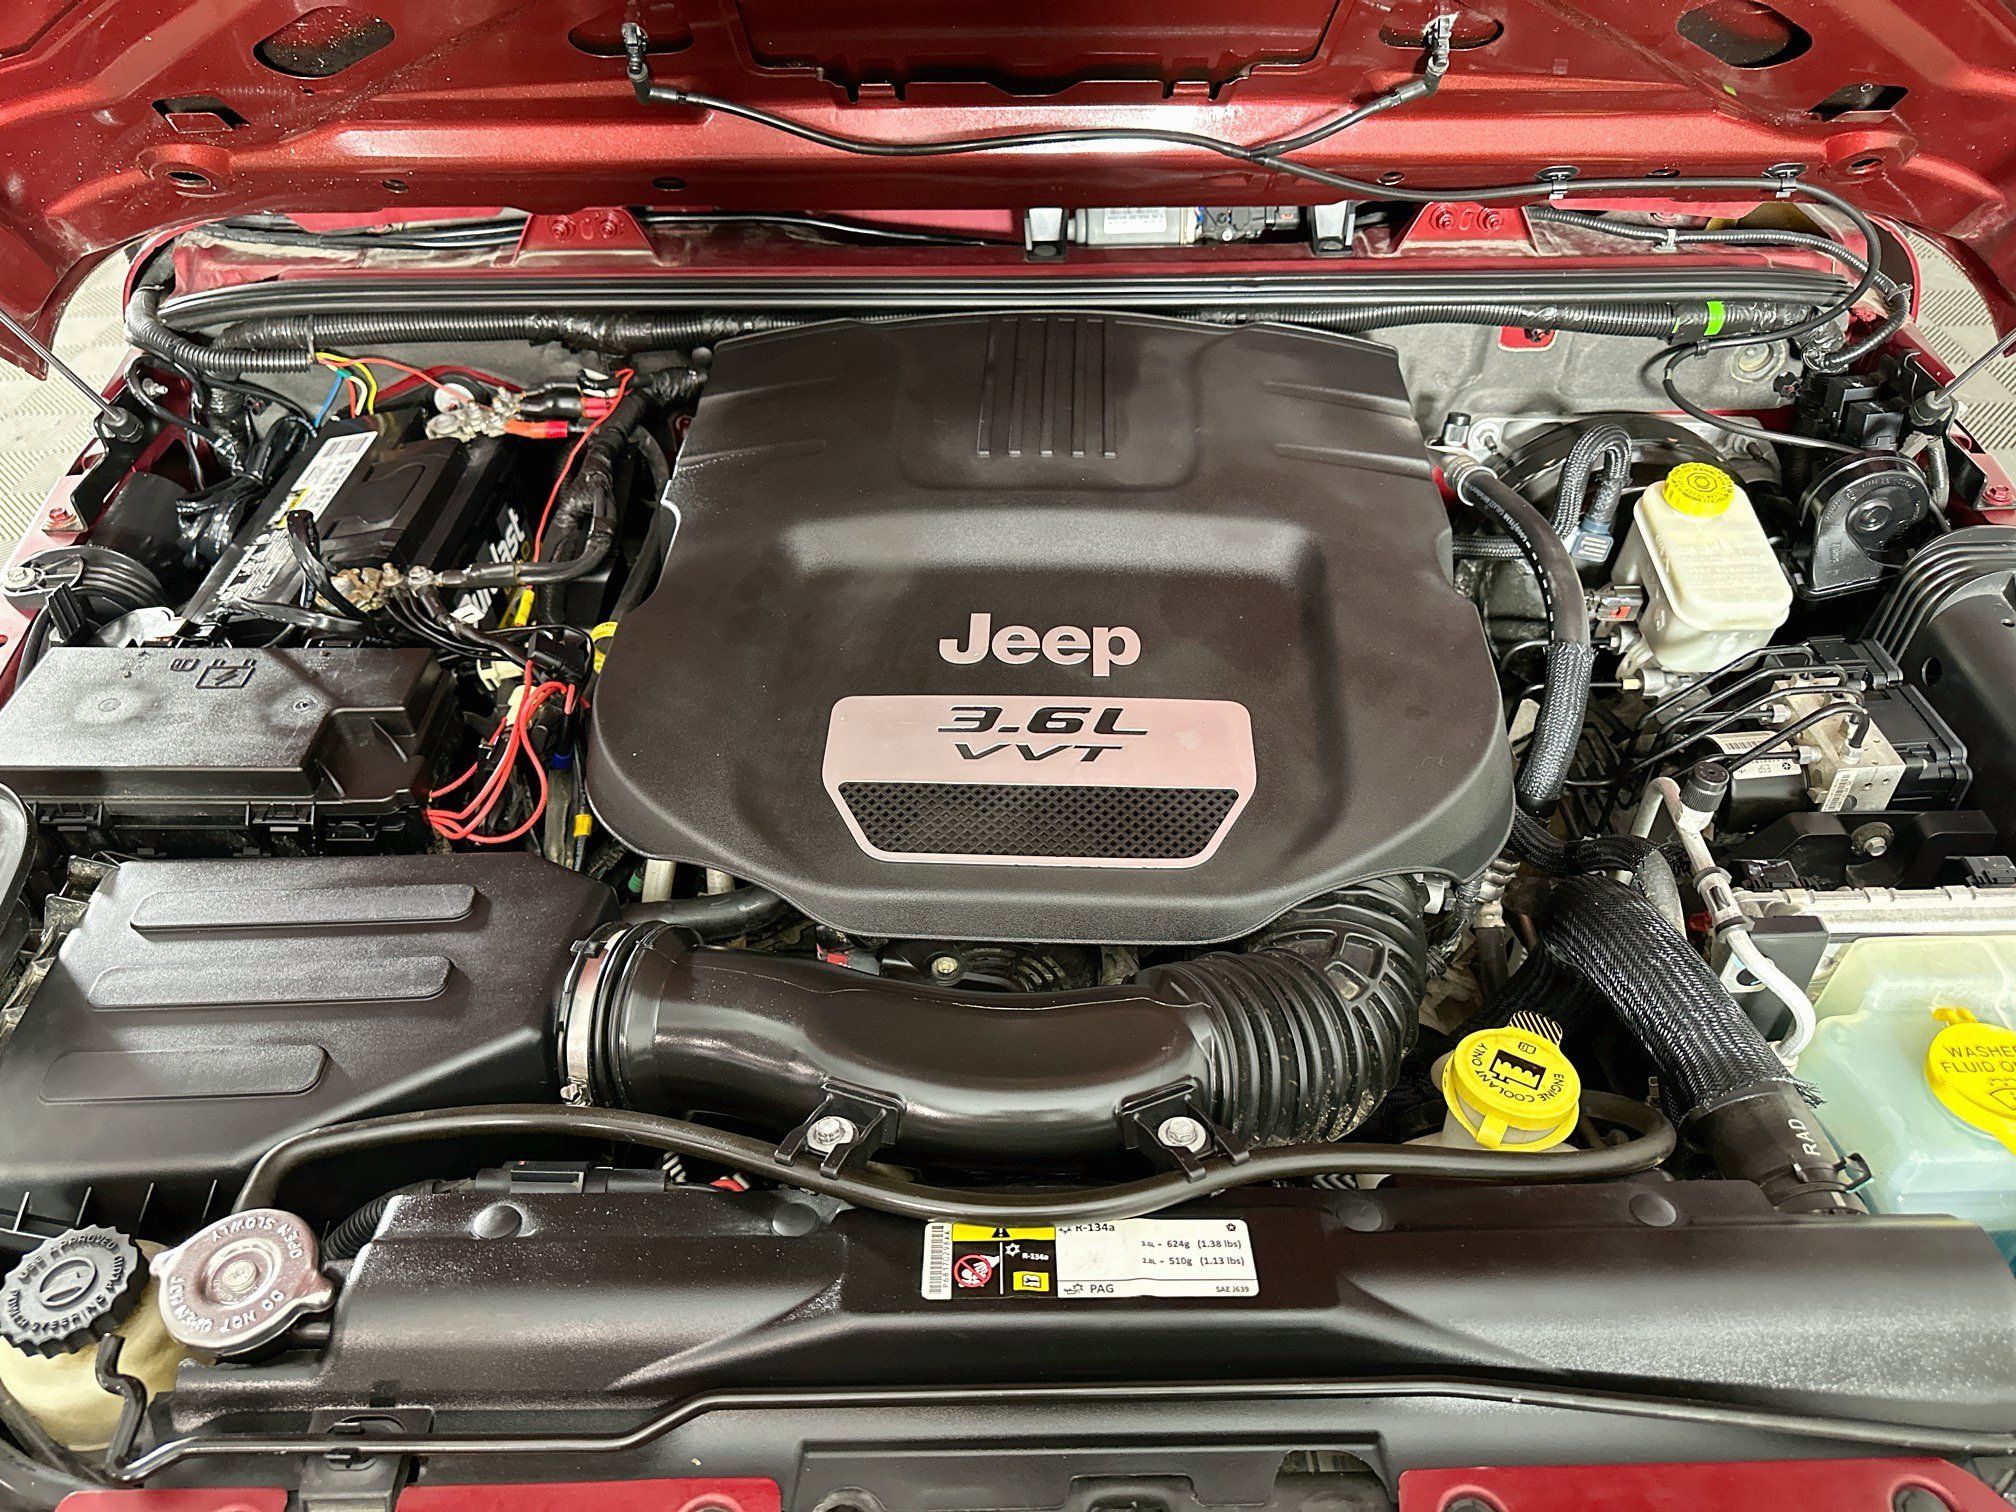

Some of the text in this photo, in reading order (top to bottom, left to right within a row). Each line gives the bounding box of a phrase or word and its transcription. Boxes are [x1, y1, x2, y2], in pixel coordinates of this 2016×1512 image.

[938, 613, 1142, 677] Jeep
[937, 706, 1148, 736] 3.6L
[953, 743, 1124, 763] VVT
[1943, 1045, 2016, 1058] WASHE
[1472, 1043, 1565, 1103] ENGINE COOLANT ONLY
[1941, 1061, 1996, 1073] FLUID
[1788, 1118, 1821, 1156] RAD
[212, 1216, 303, 1258] OPEN SLOWLY
[1166, 1240, 1190, 1249] 624g
[1197, 1240, 1222, 1249] (1.38
[1224, 1240, 1242, 1249] lbs)
[20, 1235, 117, 1281] USE APPROVED
[1169, 1257, 1193, 1267] 510g
[1200, 1257, 1224, 1267] (1.13
[1226, 1257, 1245, 1267] lbs)
[262, 1289, 285, 1311] DO
[1090, 1284, 1114, 1294] PAG
[219, 1310, 257, 1333] NOT
